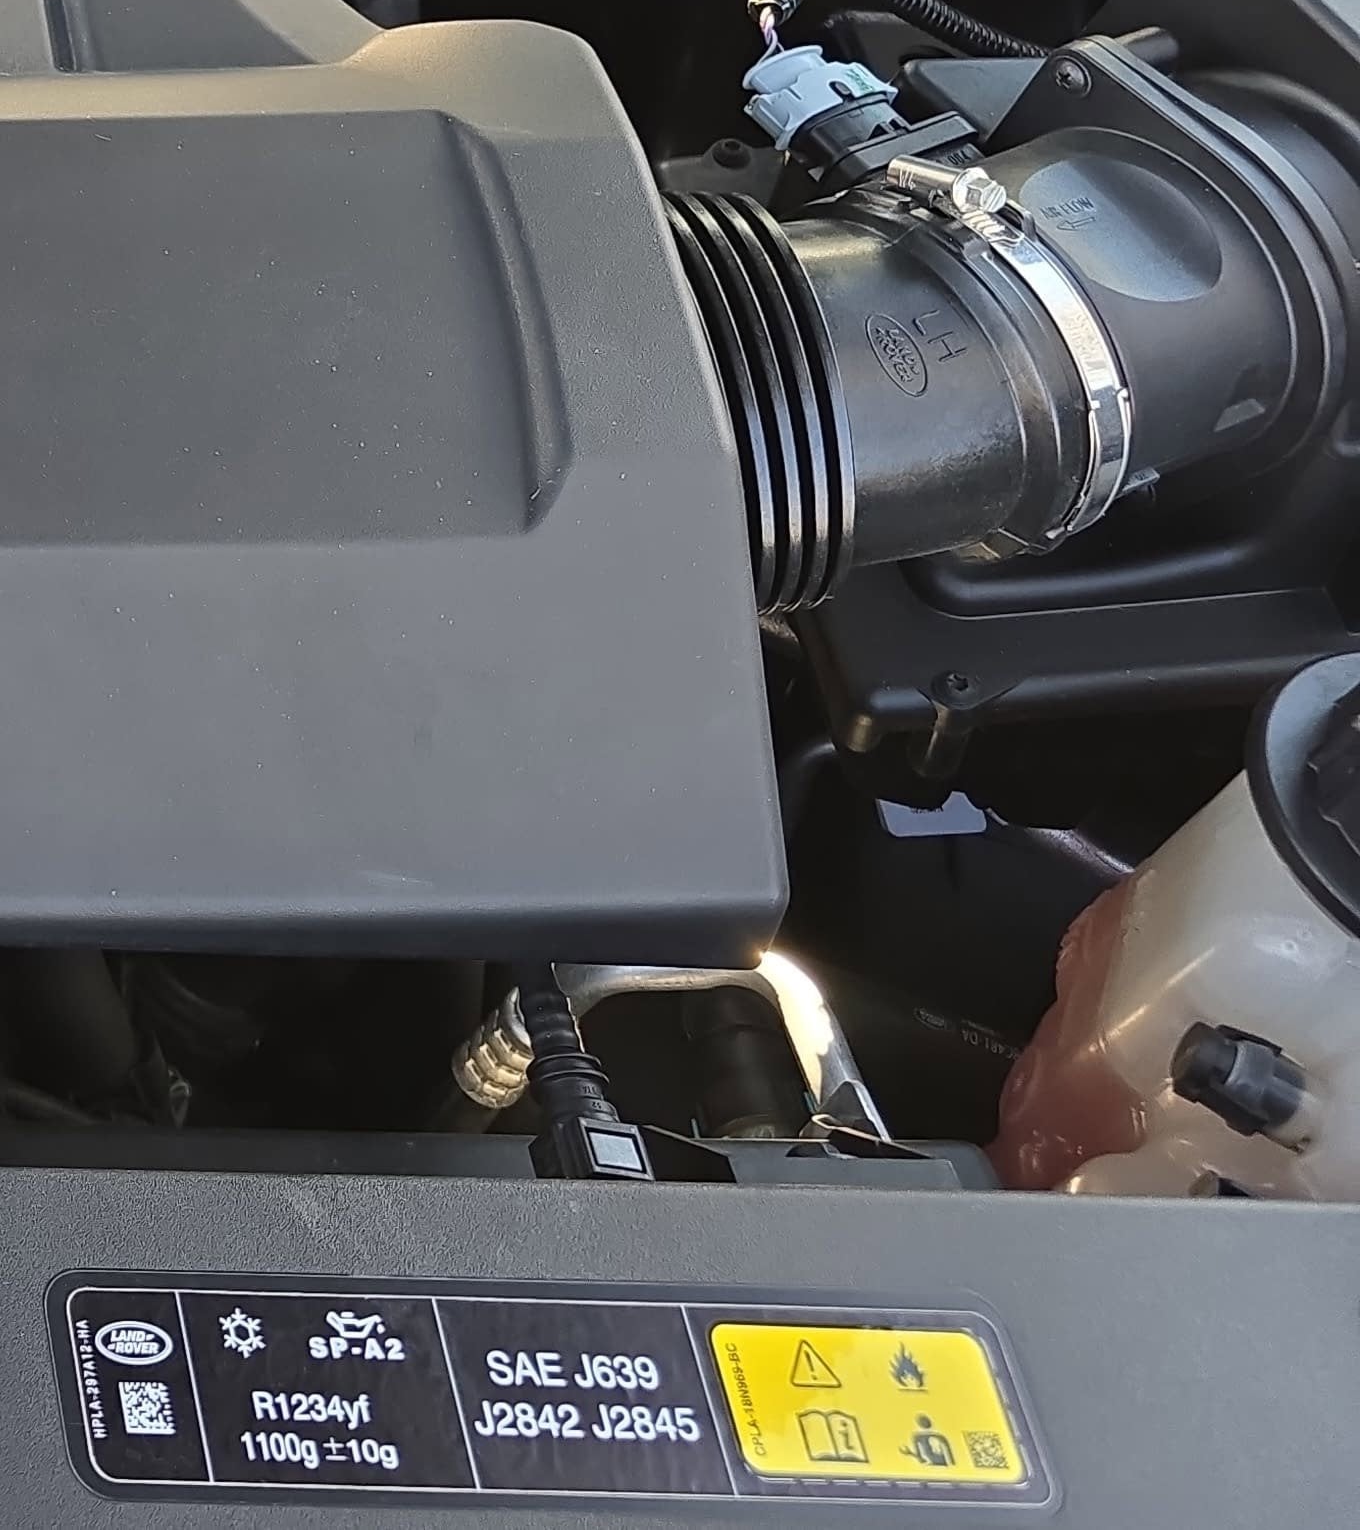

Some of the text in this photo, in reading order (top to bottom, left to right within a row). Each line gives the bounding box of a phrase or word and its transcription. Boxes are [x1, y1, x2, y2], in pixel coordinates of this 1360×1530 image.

[1059, 197, 1095, 215] FLOW
[912, 309, 967, 362] LH
[110, 1330, 147, 1343] LAND
[114, 1342, 160, 1355] ROVER
[309, 1337, 406, 1361] SP-A2
[486, 1350, 660, 1390] SAE J639
[251, 1390, 372, 1430] R1234yf
[474, 1400, 700, 1442] J2842 J2845
[240, 1431, 320, 1469] 1100g
